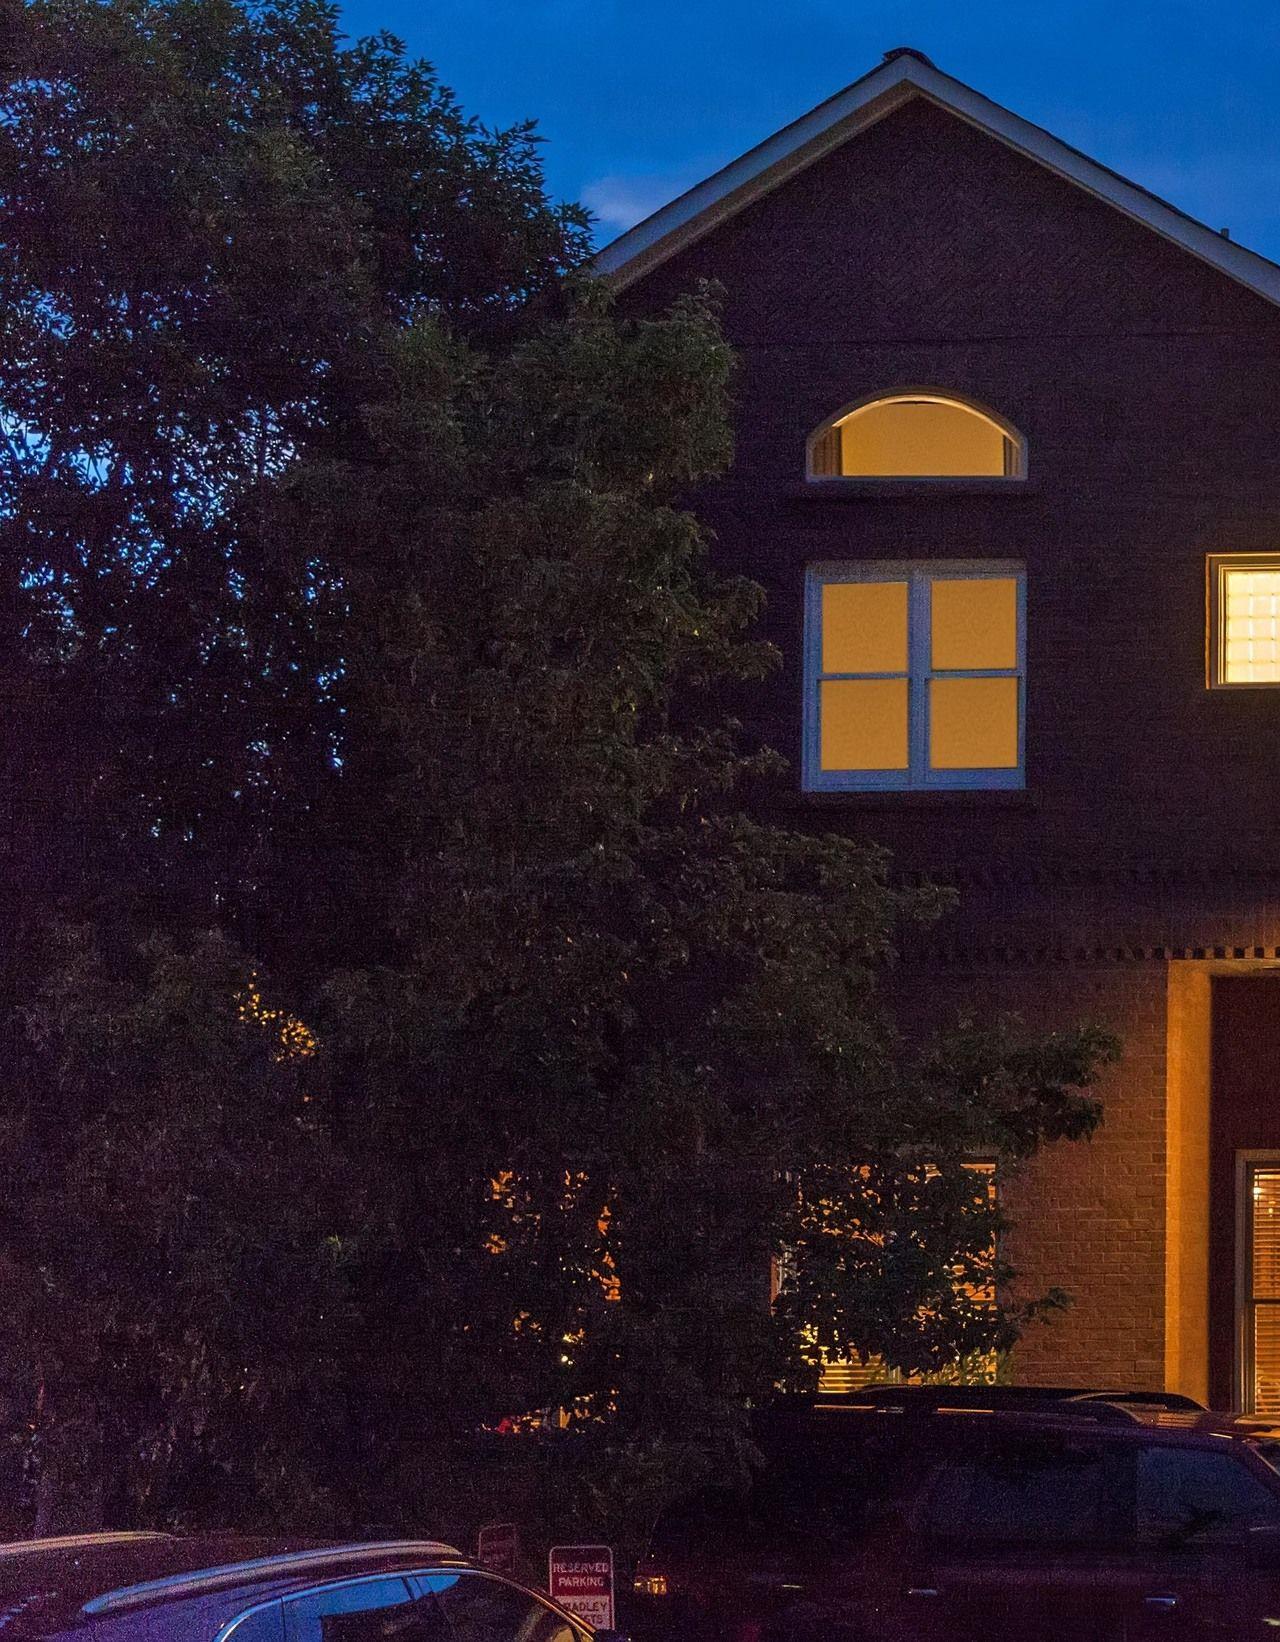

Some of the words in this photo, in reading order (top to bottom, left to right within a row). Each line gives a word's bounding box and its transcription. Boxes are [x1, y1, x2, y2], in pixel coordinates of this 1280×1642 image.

[553, 1562, 608, 1573] RESERVED
[559, 1576, 604, 1587] PARKING
[562, 1601, 607, 1612] RADLEY
